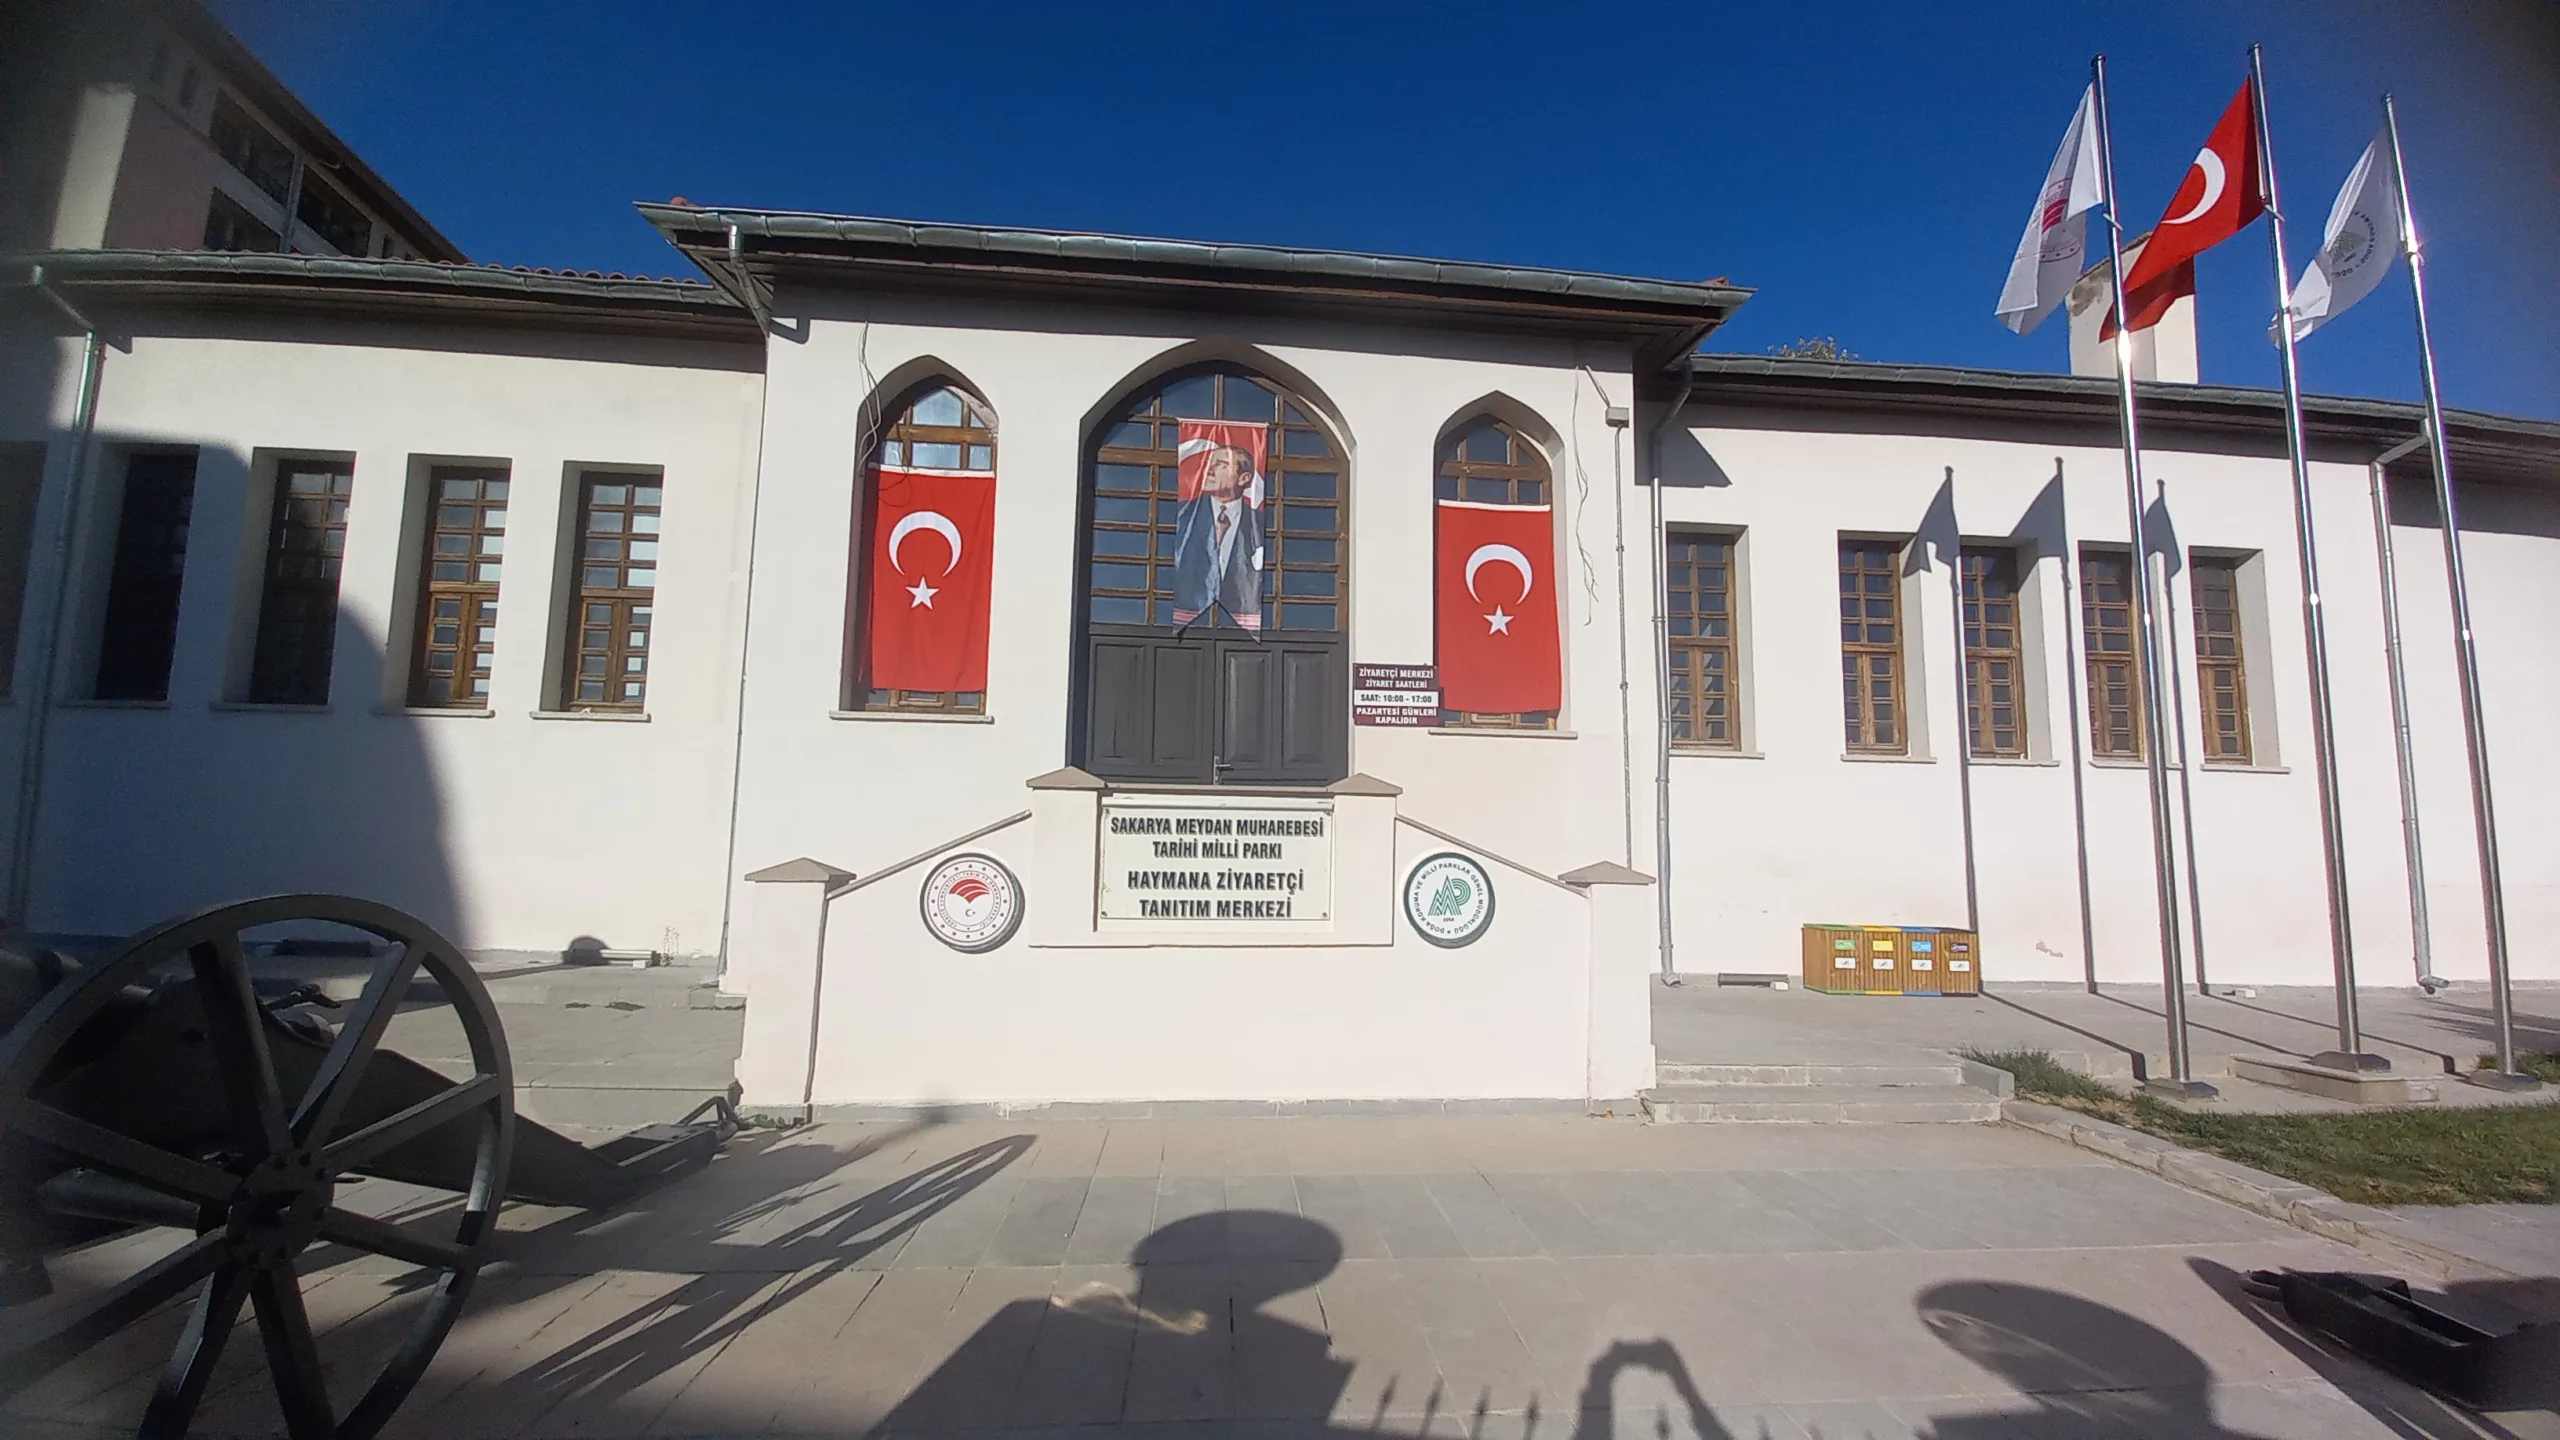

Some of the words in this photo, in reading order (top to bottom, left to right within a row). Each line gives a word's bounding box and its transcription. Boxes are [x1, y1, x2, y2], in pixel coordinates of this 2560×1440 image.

[1359, 667, 1398, 679] ZİYARETÇİ
[1400, 669, 1433, 678] MERKEZİ
[1365, 678, 1393, 687] ZİYARET
[1395, 680, 1427, 688] SAATLERİ
[1361, 694, 1381, 702] SAAT:
[1357, 707, 1399, 715] PAZARTESİ
[1402, 707, 1437, 716] GÜNLERİ
[1111, 817, 1172, 834] SAKARYA
[1176, 819, 1232, 835] MEYDAN
[1237, 817, 1324, 837] MUHAREBESİ
[1153, 838, 1198, 858] TARİHİ
[1202, 839, 1239, 859] MİLLİ
[1243, 842, 1282, 859] PARKI
[1420, 864, 1437, 880] MİLLİ
[1438, 862, 1471, 875] PARKLAR
[1128, 871, 1211, 890] HAYMANA
[1217, 868, 1304, 895] ZİYARETÇİ
[1415, 881, 1423, 889] VE
[1470, 874, 1483, 897] GENEL
[1140, 899, 1211, 917] TANITIM
[1217, 897, 1292, 917] MERKEZİ
[1414, 892, 1426, 922] KORUMA
[1454, 900, 1483, 934] MÜDÜRLÜĞÜ
[1426, 921, 1445, 934] DOĞA
